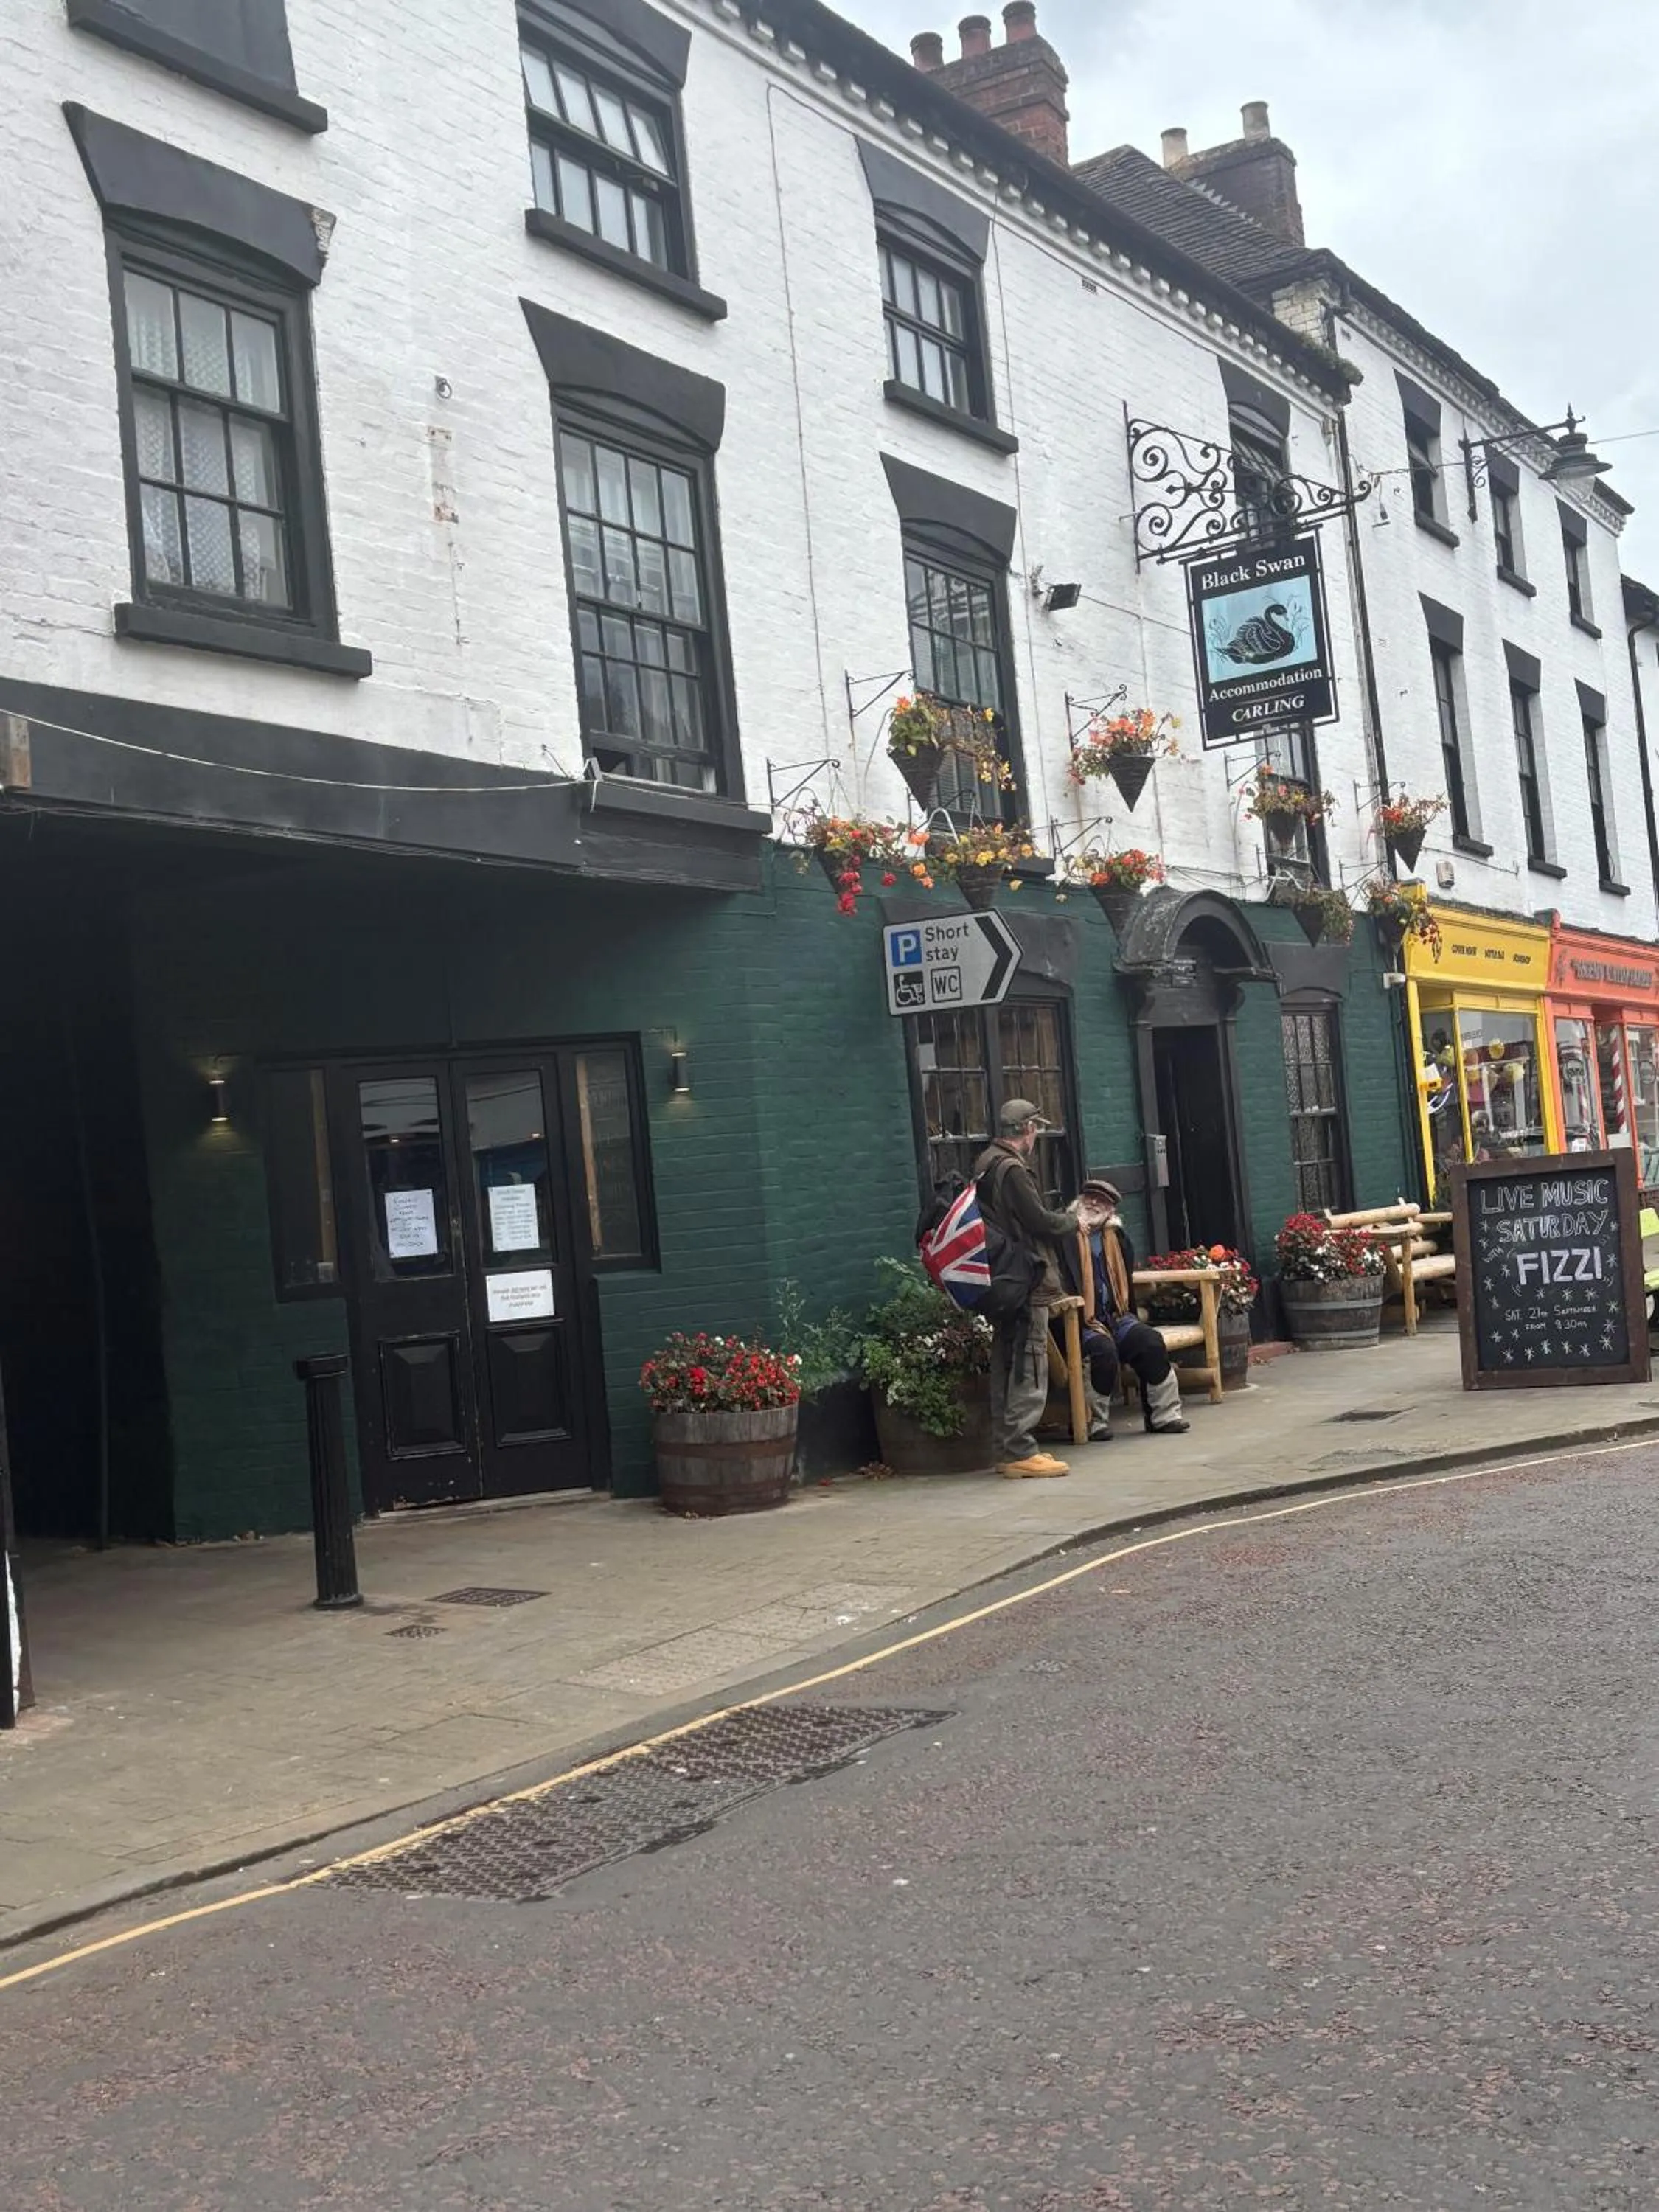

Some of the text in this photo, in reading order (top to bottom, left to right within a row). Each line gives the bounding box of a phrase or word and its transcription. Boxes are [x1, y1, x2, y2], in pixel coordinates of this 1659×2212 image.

[1202, 555, 1305, 590] Black Swan
[1209, 668, 1322, 702] Accommodation
[1232, 695, 1304, 722] CARLING
[897, 922, 970, 963] P Short
[925, 946, 958, 961] stay
[934, 975, 958, 994] WC
[1481, 1178, 1609, 1214] LIVE MUSIC
[1496, 1209, 1609, 1242] SATURDAY
[1517, 1247, 1602, 1285] FIZZI
